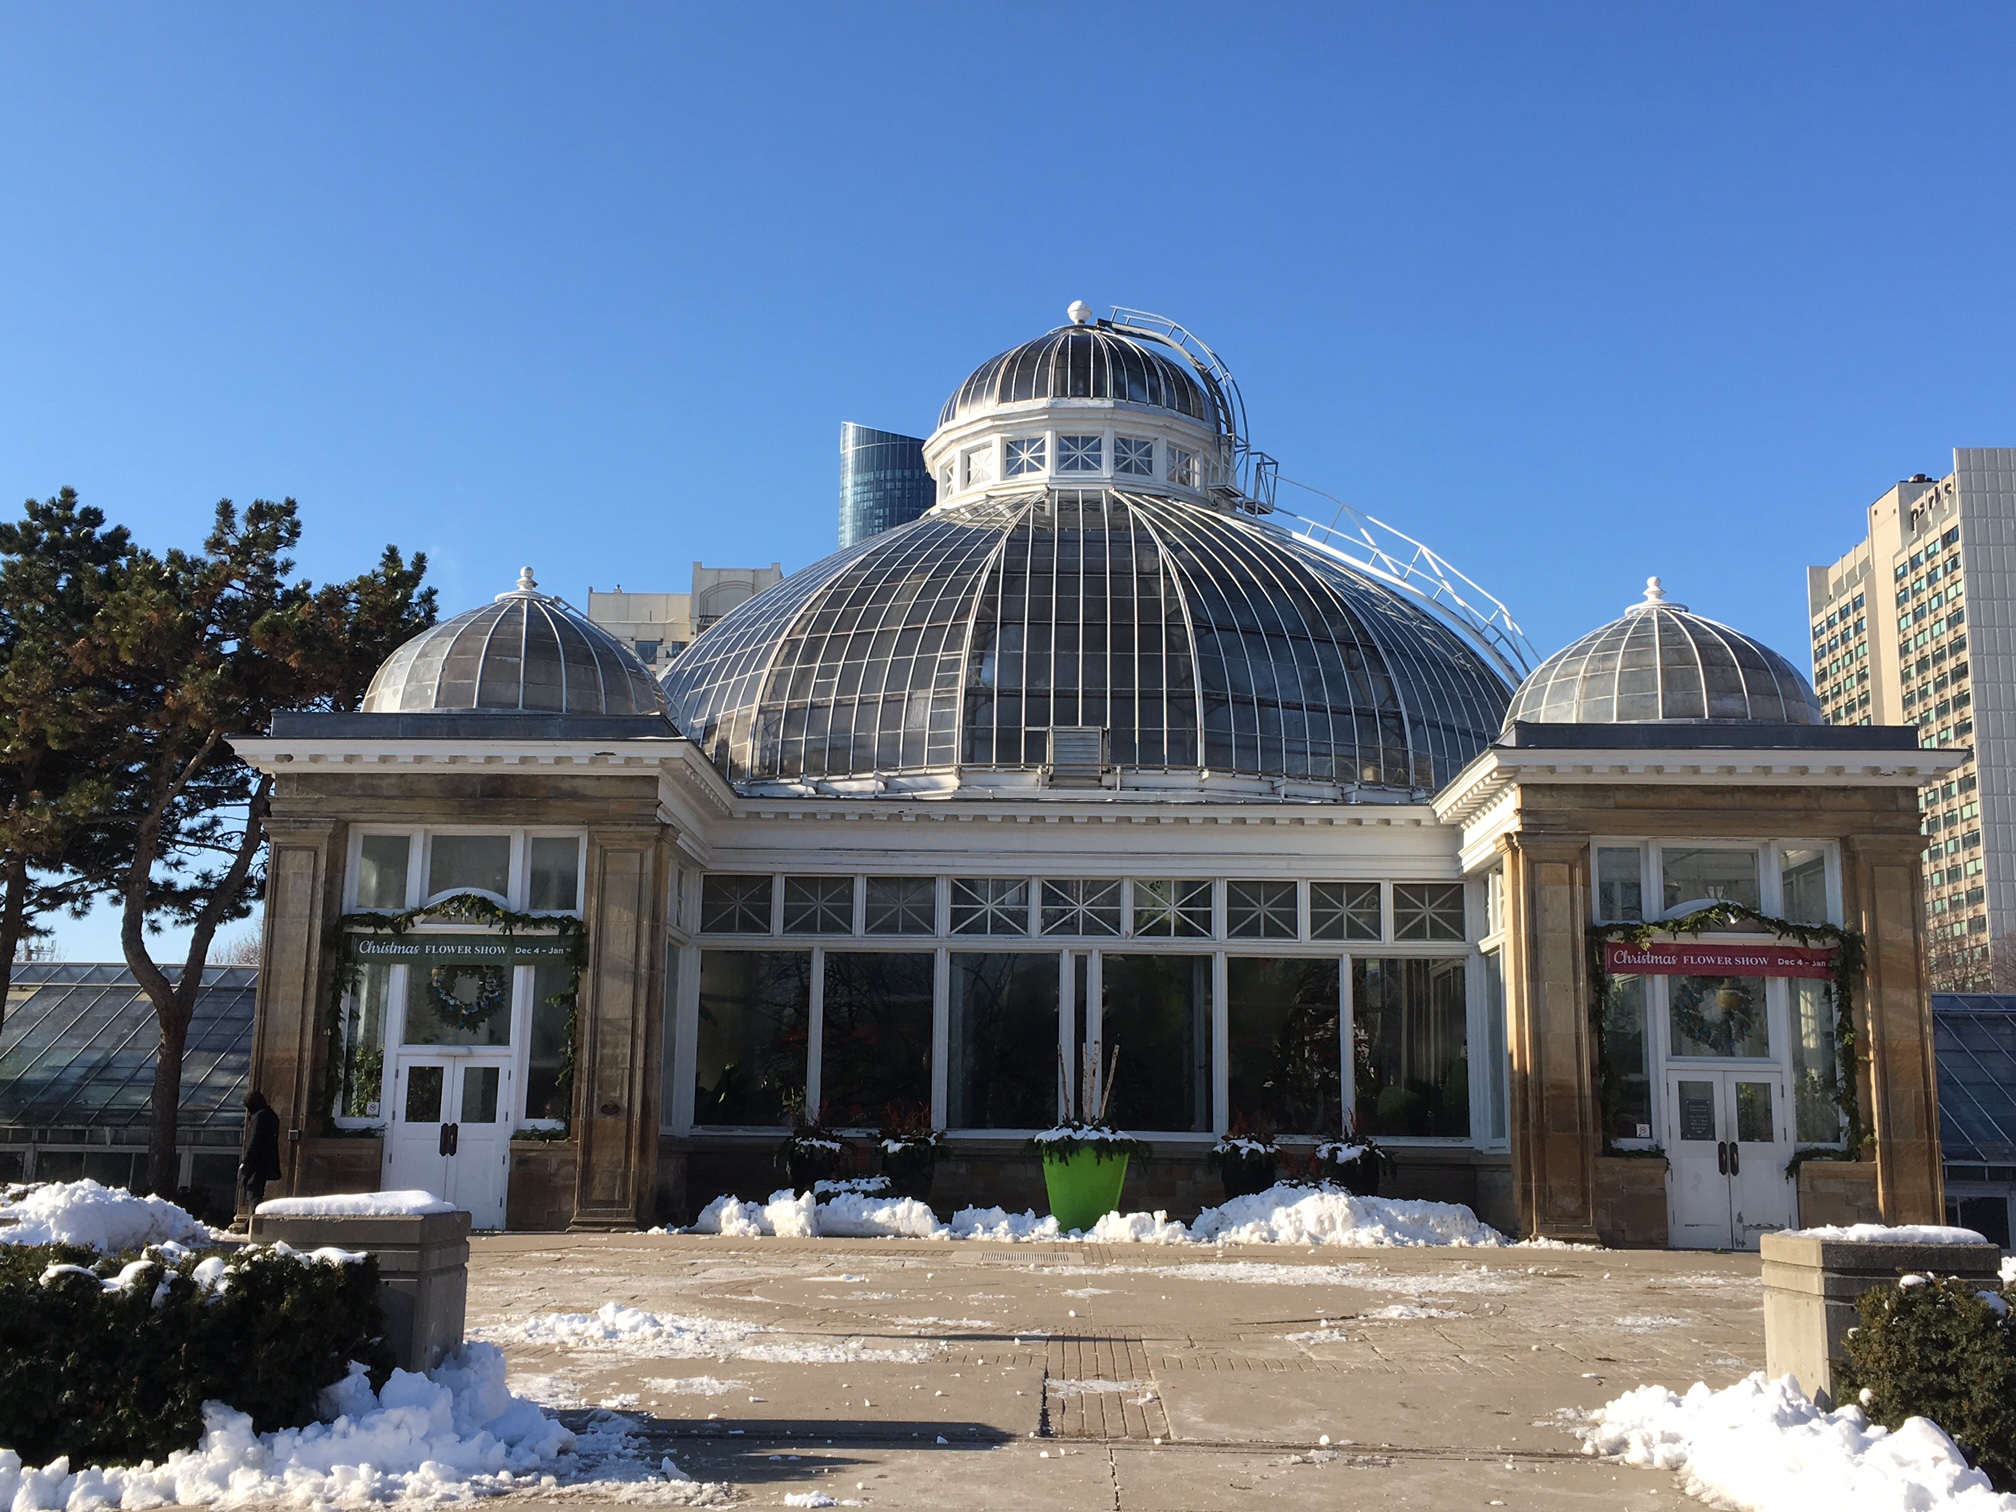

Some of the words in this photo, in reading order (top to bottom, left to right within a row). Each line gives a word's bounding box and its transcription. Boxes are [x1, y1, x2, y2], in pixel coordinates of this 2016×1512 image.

[359, 940, 420, 955] Christmas
[425, 945, 472, 954] FLOWER
[473, 945, 507, 955] SHOW
[514, 946, 532, 955] Dec
[533, 946, 540, 955] 4
[548, 946, 564, 955] Jan
[1613, 949, 1679, 965] Christmas
[1683, 955, 1732, 965] FLOWER
[1734, 956, 1769, 966] SHOW
[1777, 957, 1795, 966] Dec
[1796, 958, 1804, 966] 4
